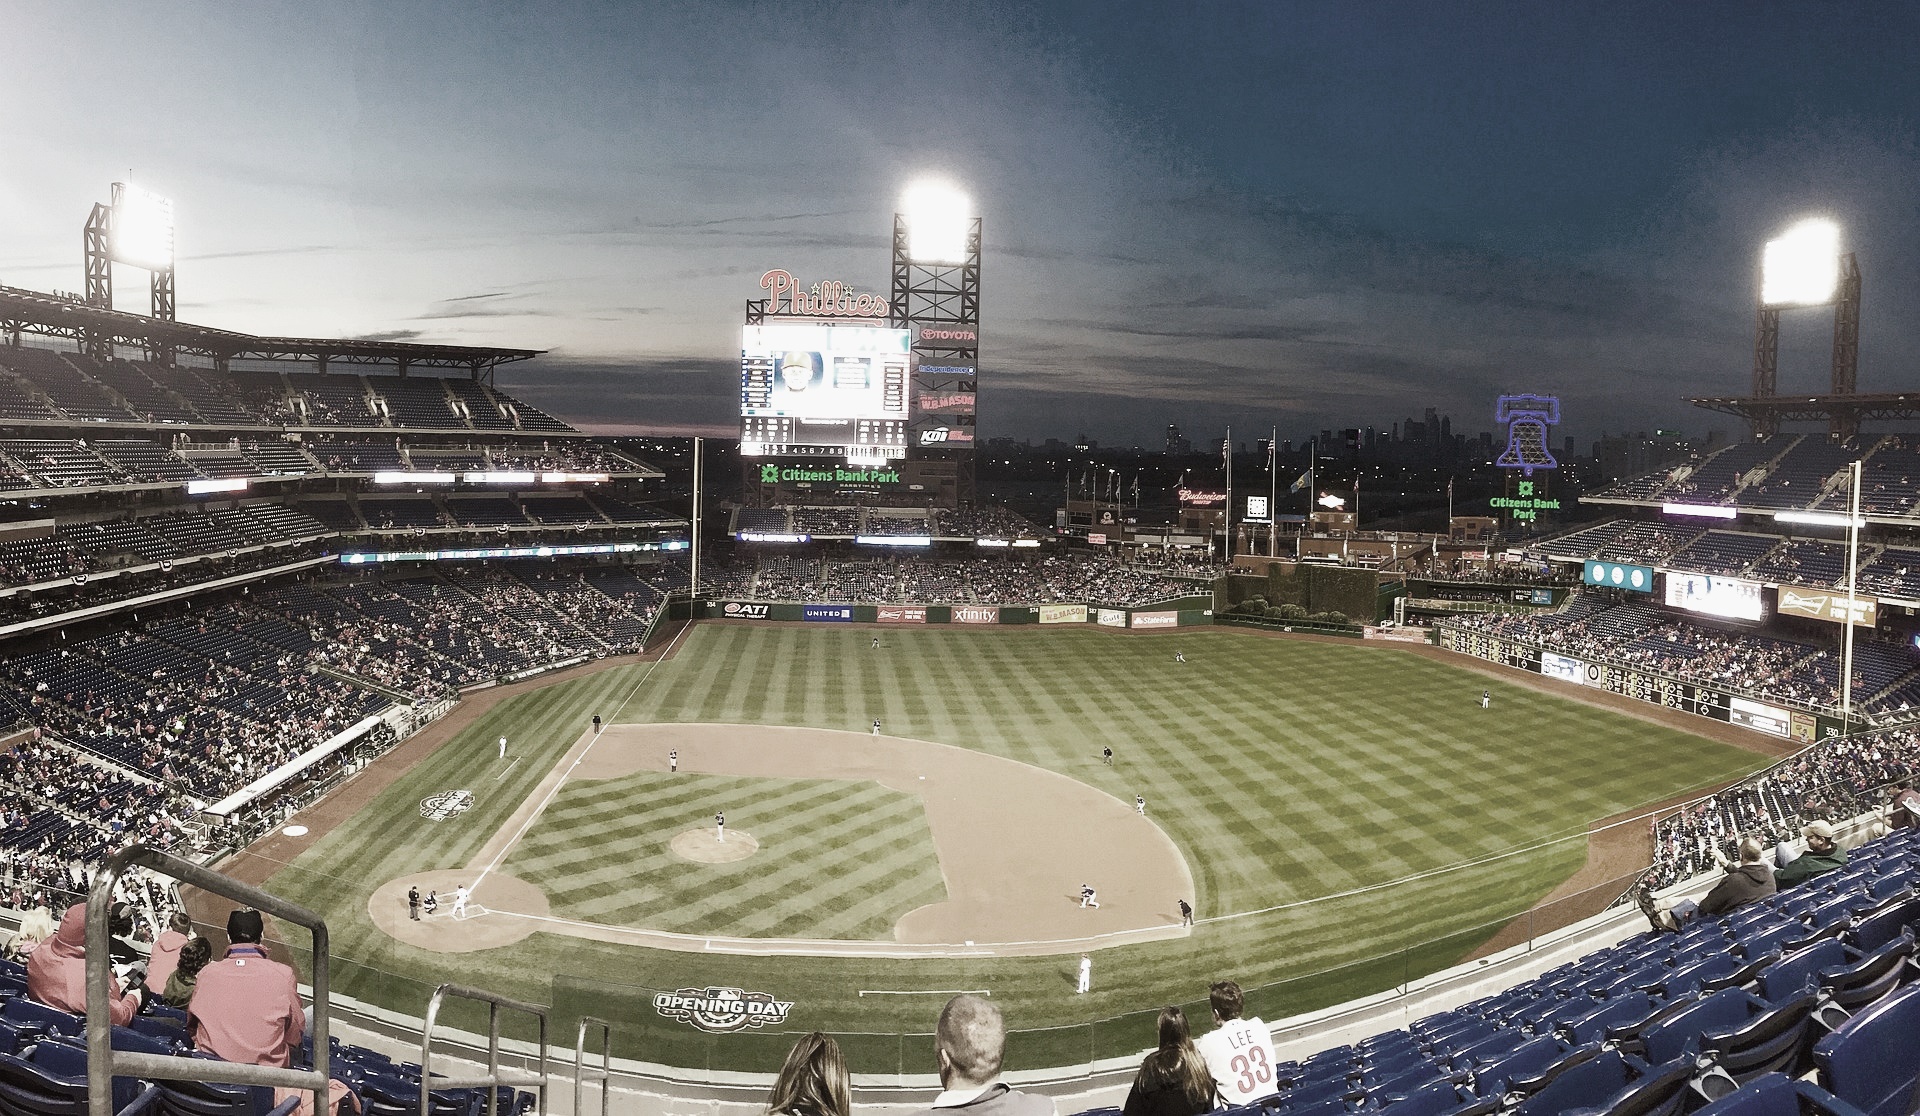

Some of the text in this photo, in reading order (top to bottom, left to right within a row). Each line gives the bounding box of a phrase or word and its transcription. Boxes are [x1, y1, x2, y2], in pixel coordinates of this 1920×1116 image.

[760, 269, 889, 317] Phillies
[935, 330, 976, 340] TOYOTA
[920, 430, 948, 442] KDI
[782, 469, 900, 483] Citizens Bank Park
[1178, 489, 1227, 501] Budweiser
[1489, 498, 1560, 509] Citizens Bank
[1513, 509, 1536, 520] Park
[739, 604, 769, 615] ATI
[1103, 613, 1120, 623] Gulf
[1825, 727, 1839, 737] 330
[655, 995, 791, 1016] OPENING DAY
[1228, 1029, 1254, 1050] LEE
[1230, 1045, 1272, 1094] 33
